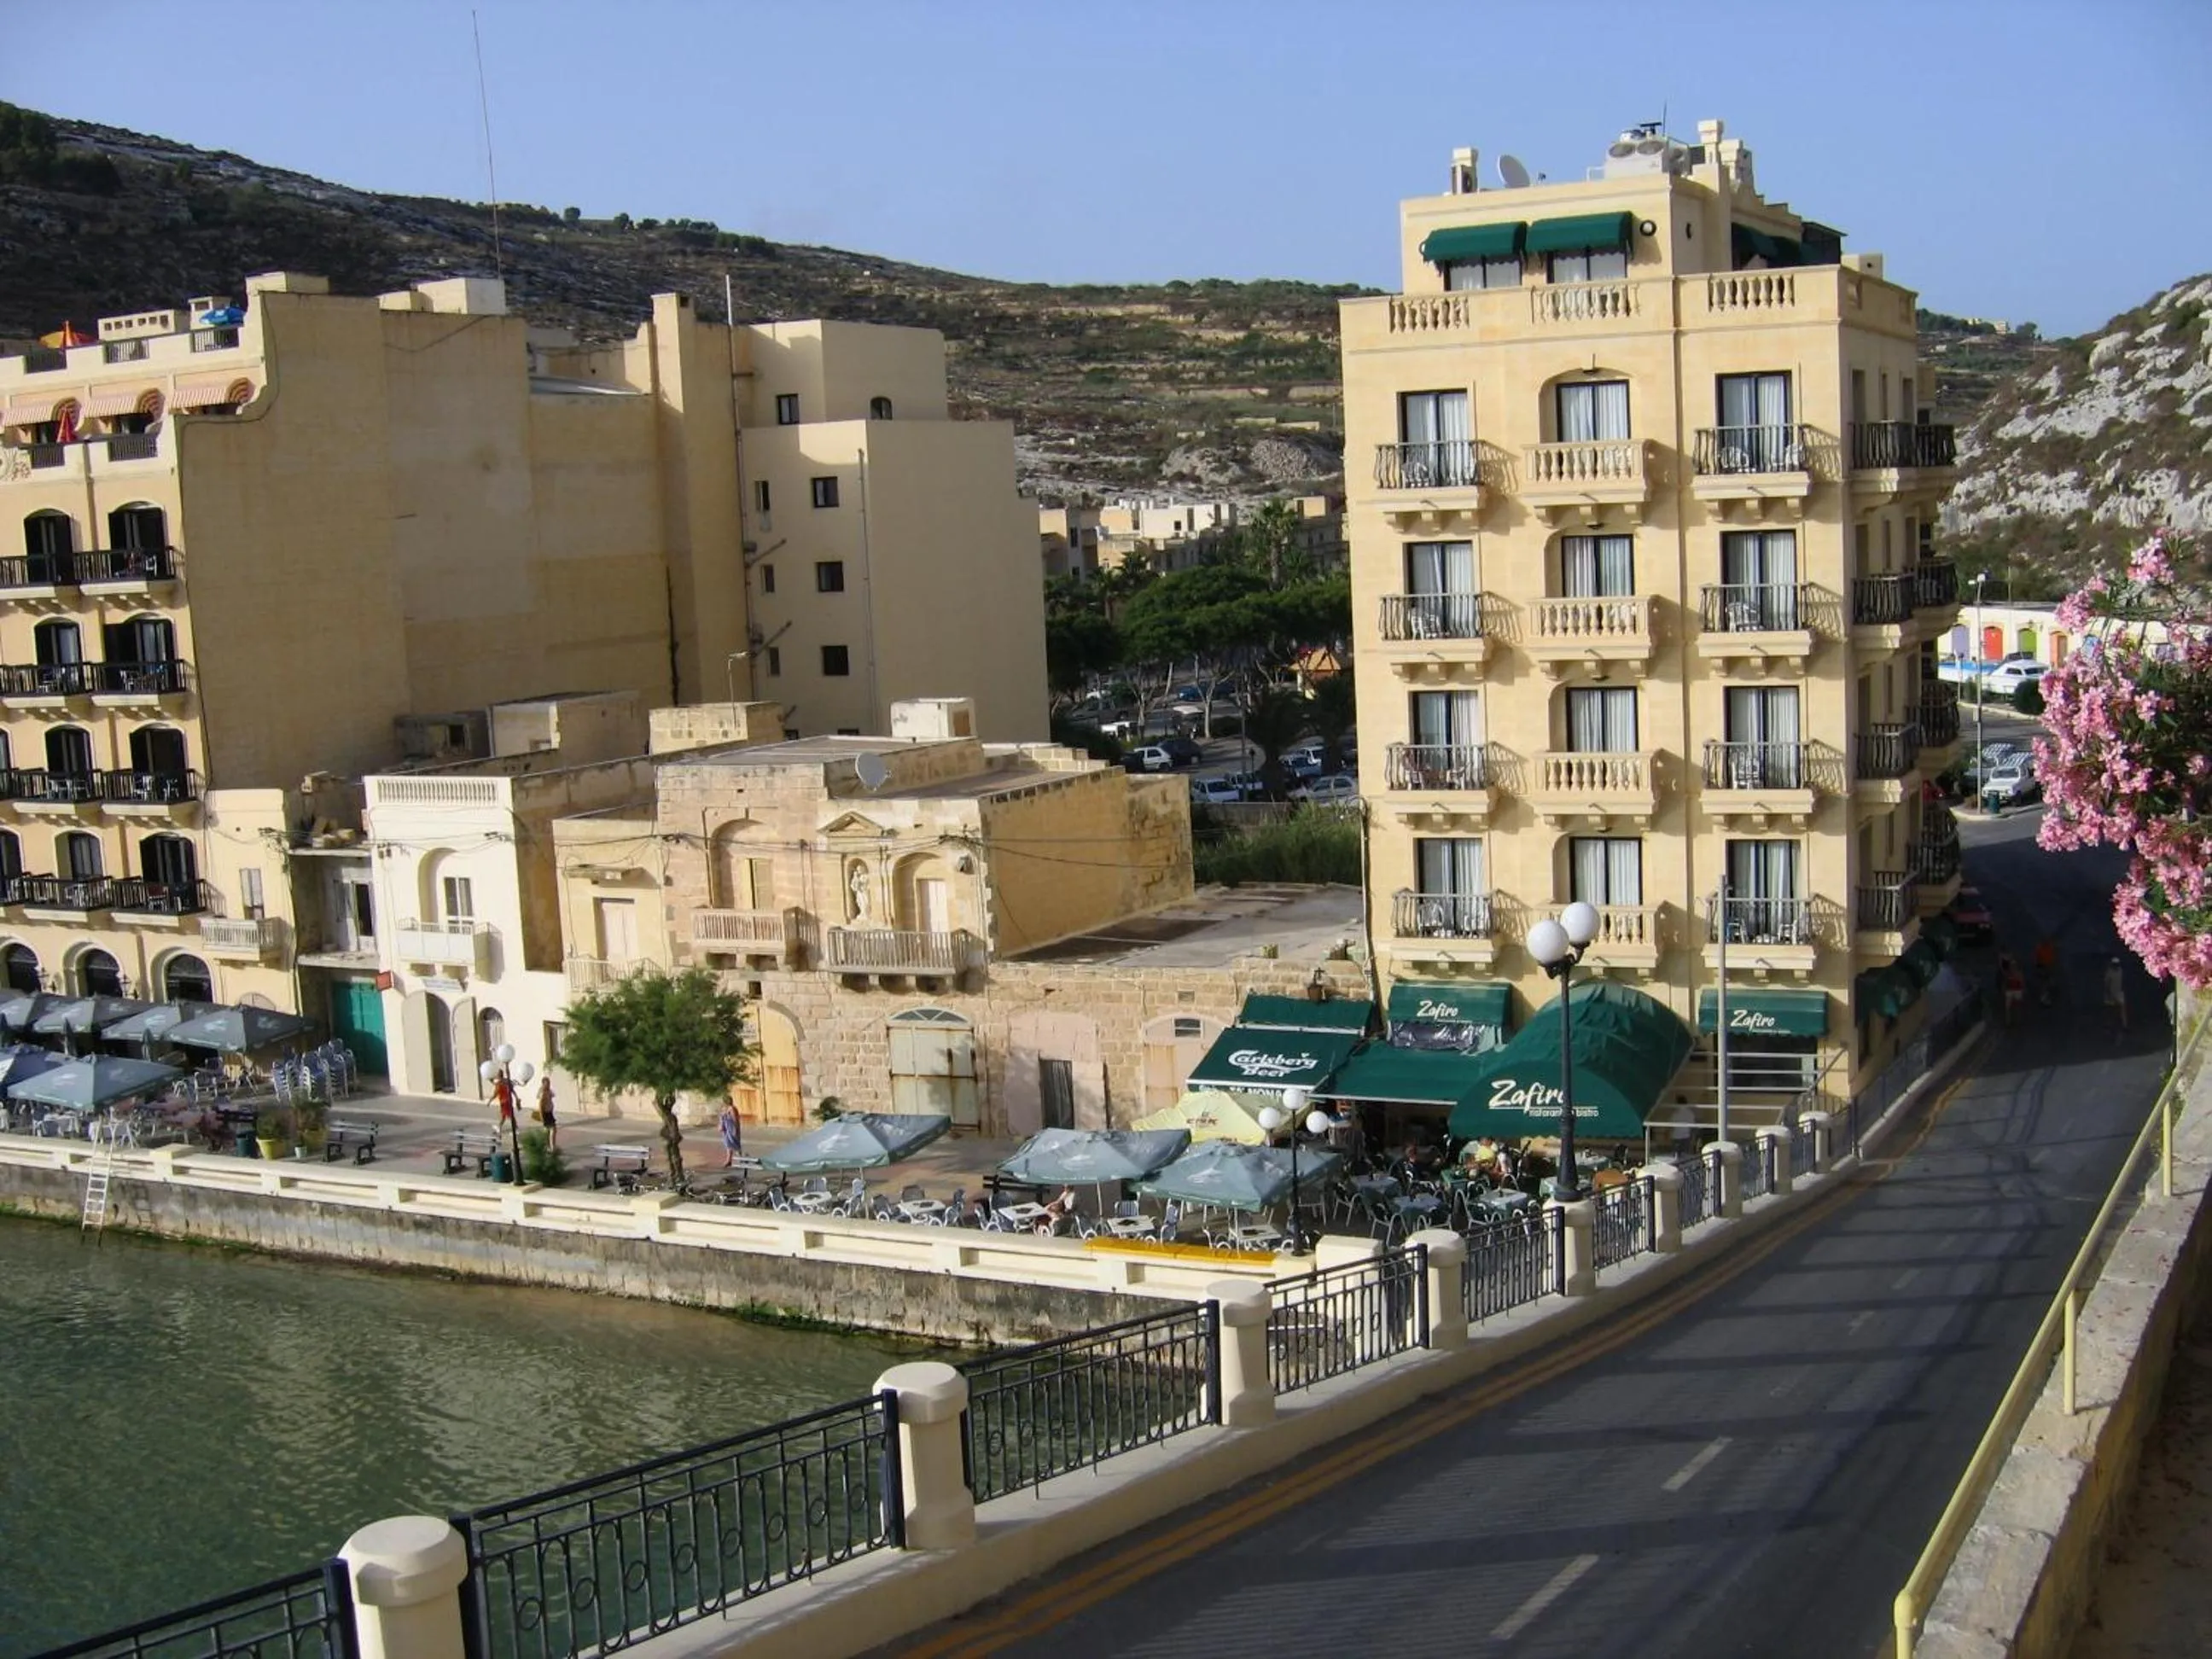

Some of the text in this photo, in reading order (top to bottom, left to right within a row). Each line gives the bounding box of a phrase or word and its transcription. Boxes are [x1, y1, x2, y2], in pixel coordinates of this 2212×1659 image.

[1417, 1000, 1458, 1020] Zafiro
[1731, 1010, 1775, 1031] Zafiro
[1228, 1050, 1318, 1069] Carlsberg
[1242, 1066, 1290, 1077] Beer
